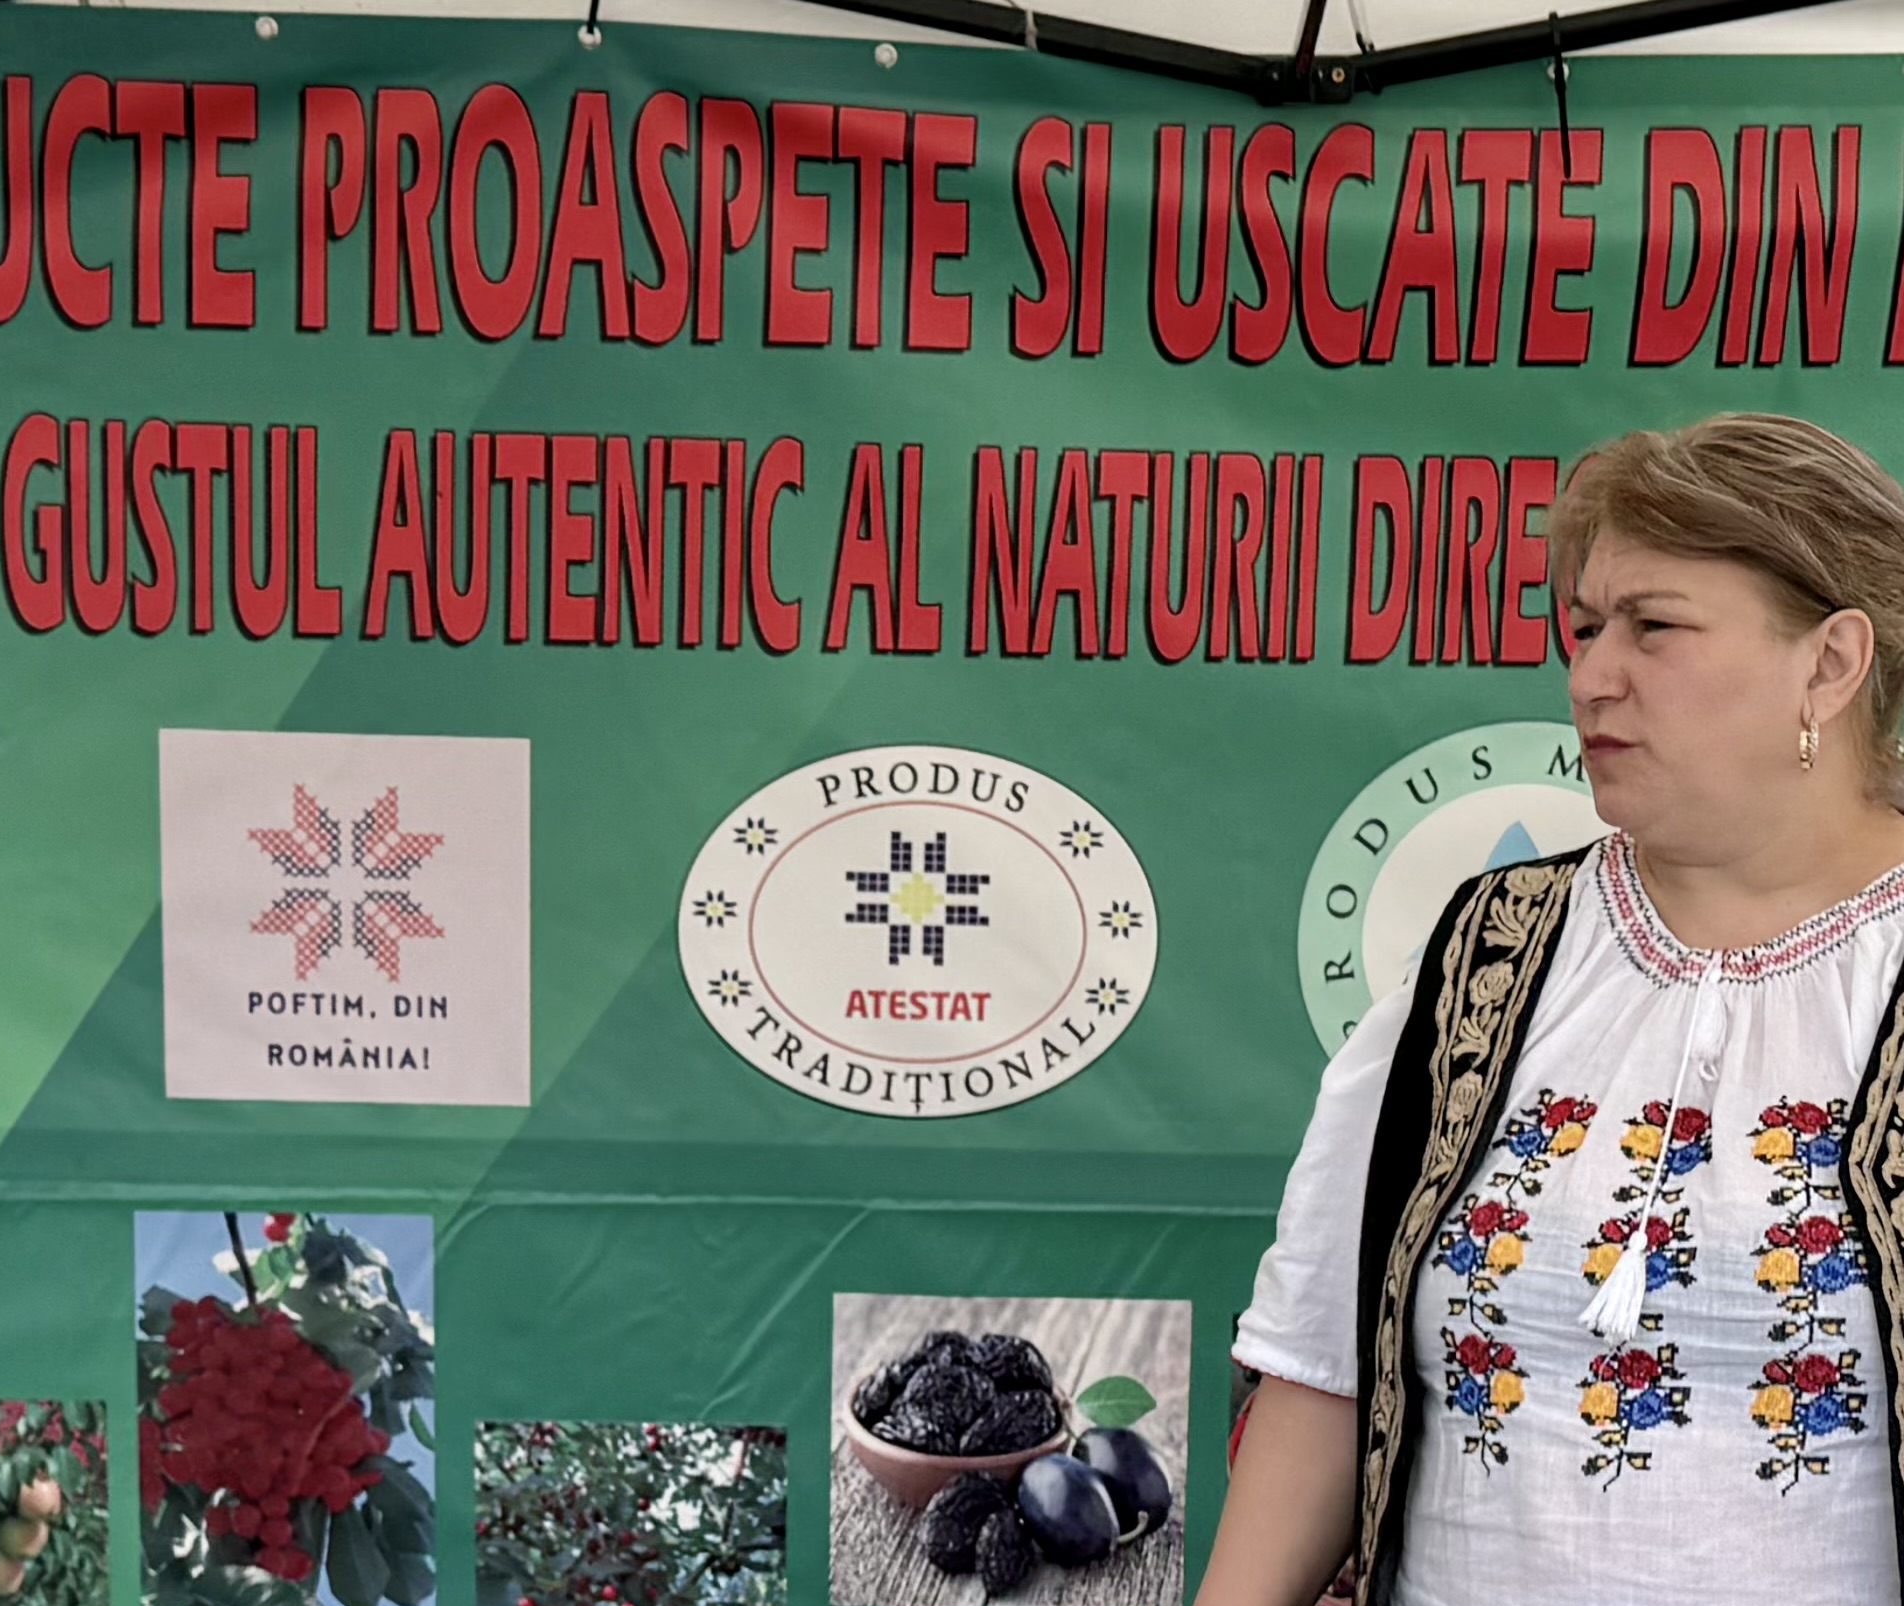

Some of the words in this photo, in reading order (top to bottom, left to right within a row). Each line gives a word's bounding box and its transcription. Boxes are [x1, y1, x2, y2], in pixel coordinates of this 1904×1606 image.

[296, 82, 979, 352] PROASPETE
[1011, 113, 1106, 356] SI
[1146, 122, 1604, 366] USCATE
[1625, 122, 1862, 369] DIN
[360, 425, 806, 655] AUTENTIC
[822, 442, 944, 655] AL
[966, 442, 1324, 663] NATURII
[1345, 453, 1581, 666] DIRE
[817, 762, 1030, 812] PRODUS
[248, 991, 377, 1020] POFTIM,
[393, 994, 448, 1018] DIN
[845, 988, 992, 1021] ATESTAT
[267, 1037, 430, 1070] ROMÂNIA!
[745, 1005, 1096, 1113] TRADIȚIONAL
